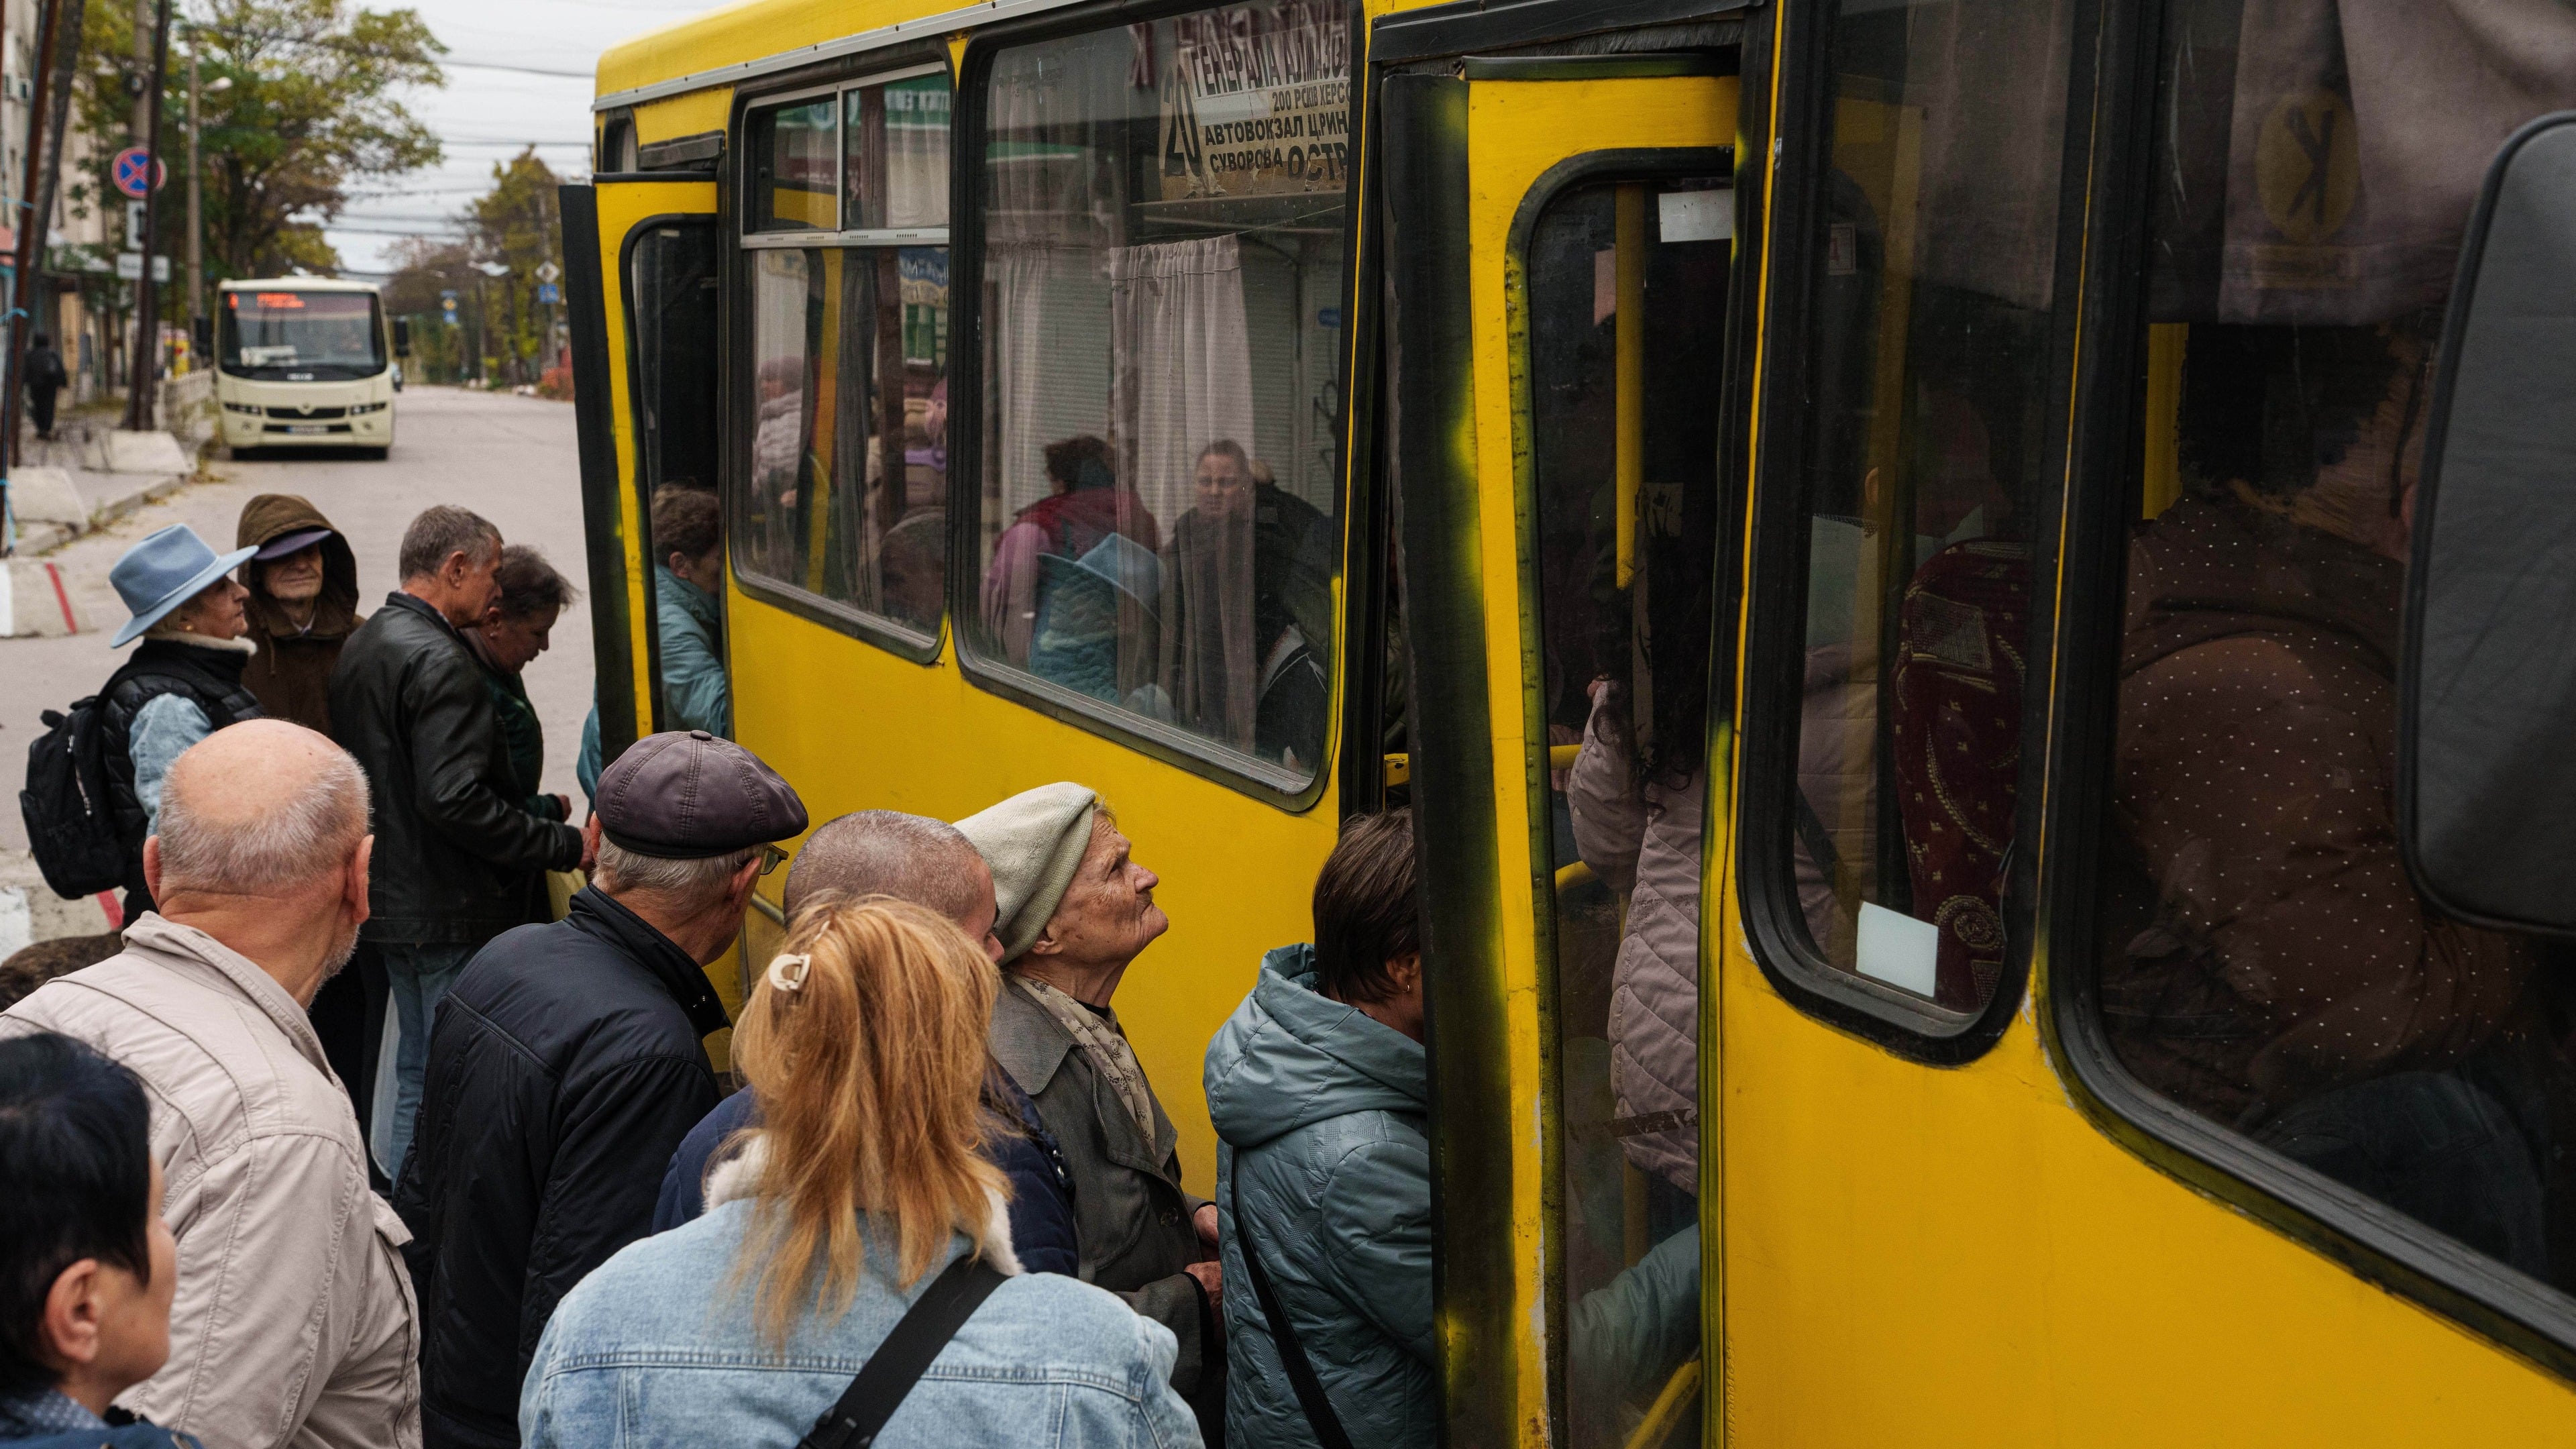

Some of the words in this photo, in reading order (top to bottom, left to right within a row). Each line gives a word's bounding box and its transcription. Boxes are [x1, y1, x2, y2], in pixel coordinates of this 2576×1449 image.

[1190, 35, 1281, 97] ГЕНЕРАЛА
[1272, 90, 1292, 112] 200
[1165, 64, 1201, 178] 20
[1205, 115, 1304, 146] АВТОВОКЗАЛ
[1210, 147, 1283, 173] СУВОРОВА
